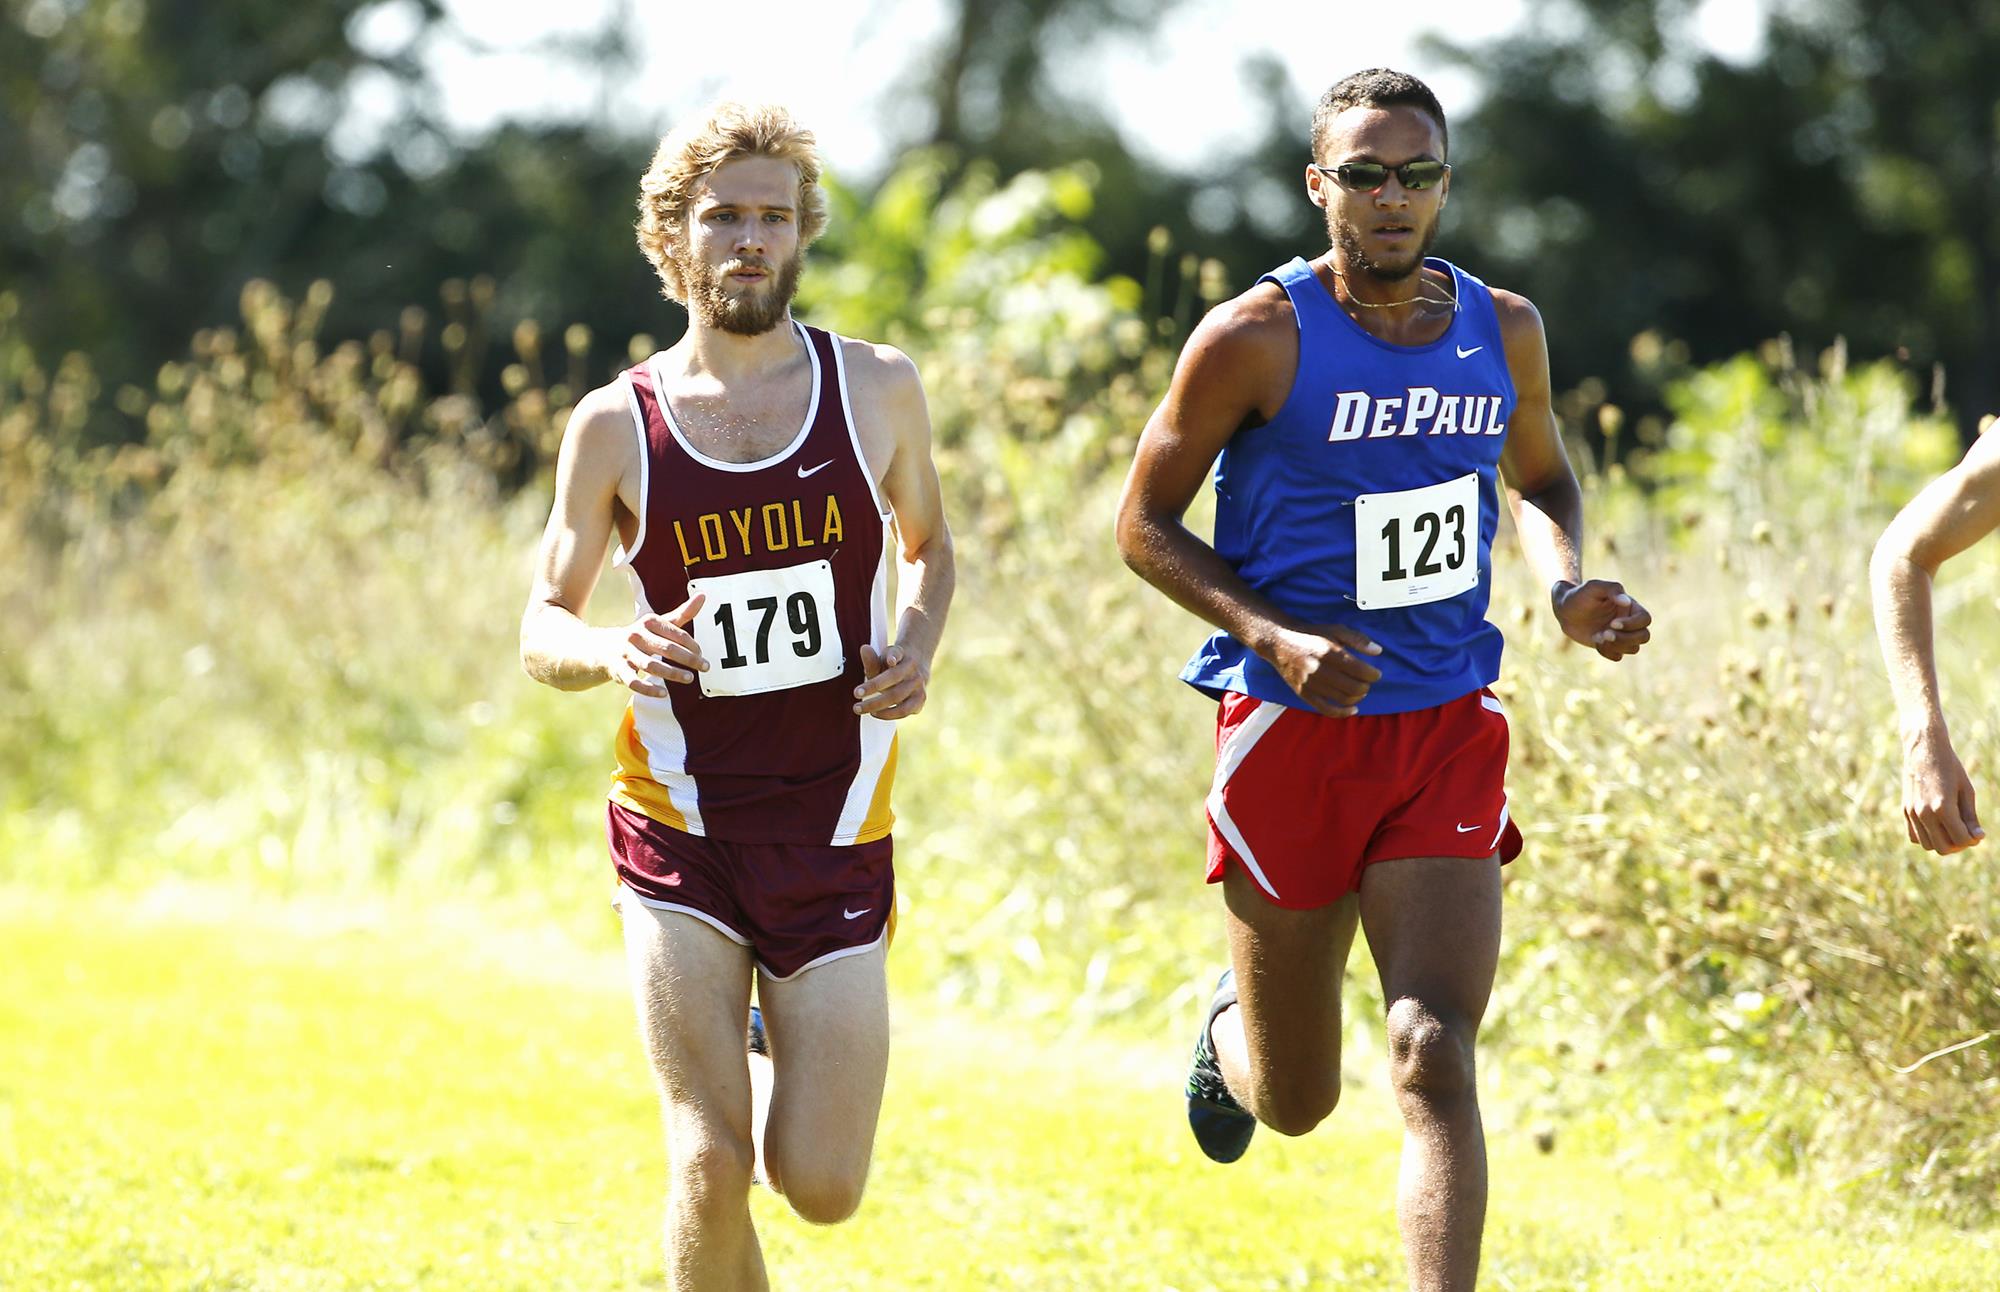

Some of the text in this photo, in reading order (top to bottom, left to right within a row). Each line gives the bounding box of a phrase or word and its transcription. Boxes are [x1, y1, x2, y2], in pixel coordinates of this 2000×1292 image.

[673, 494, 843, 566] LOYOLA
[1381, 504, 1466, 582] 123
[714, 591, 822, 669] 179
